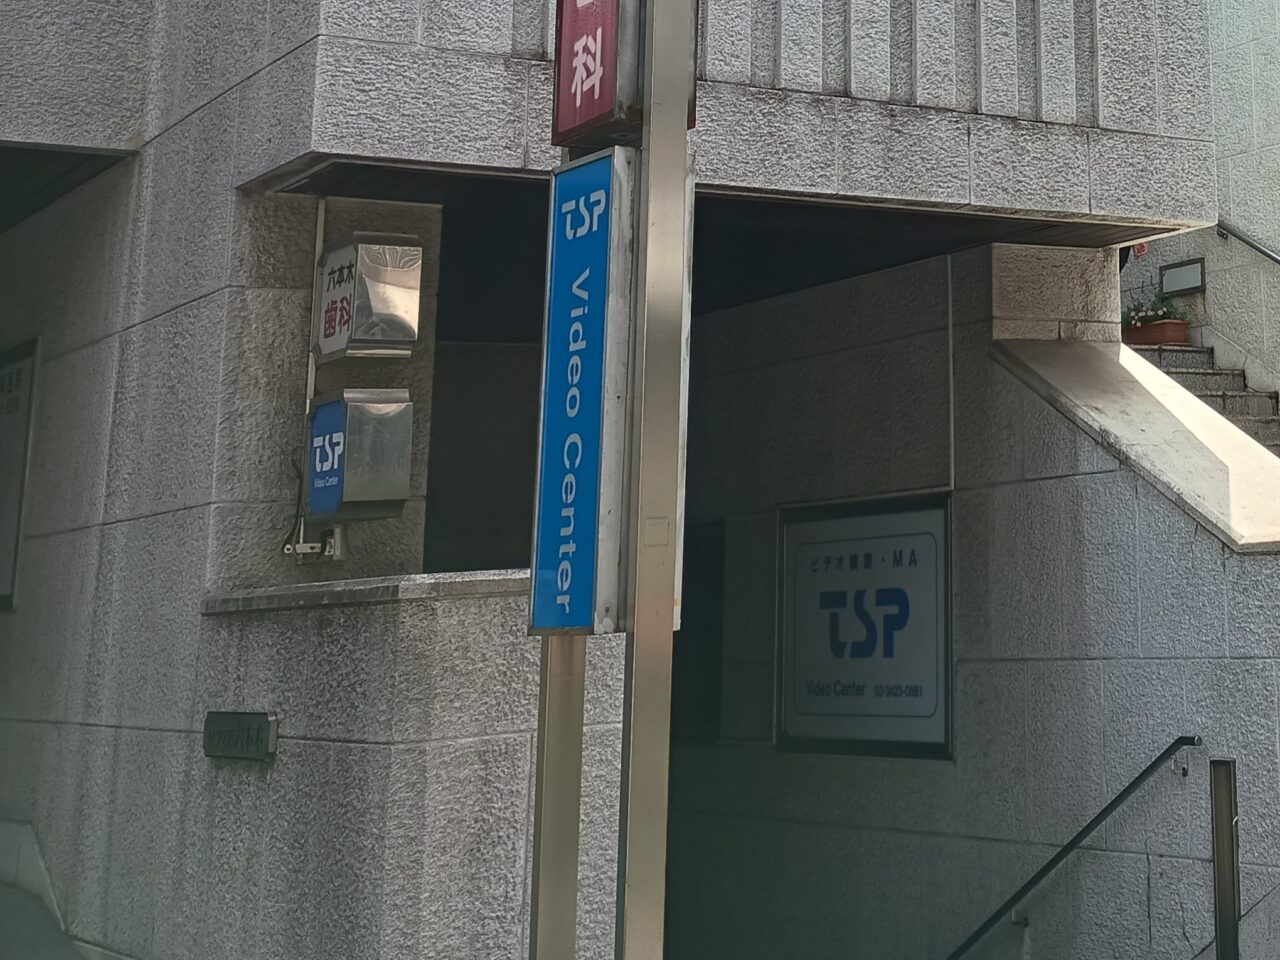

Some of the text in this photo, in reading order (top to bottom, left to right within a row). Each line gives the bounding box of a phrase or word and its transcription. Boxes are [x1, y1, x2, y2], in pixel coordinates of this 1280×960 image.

[561, 189, 607, 239] TSP
[326, 260, 354, 293] 六本木
[324, 293, 352, 339] 歯科
[313, 431, 344, 473] TSP
[556, 268, 590, 614] Video Center
[819, 586, 910, 659] TSP
